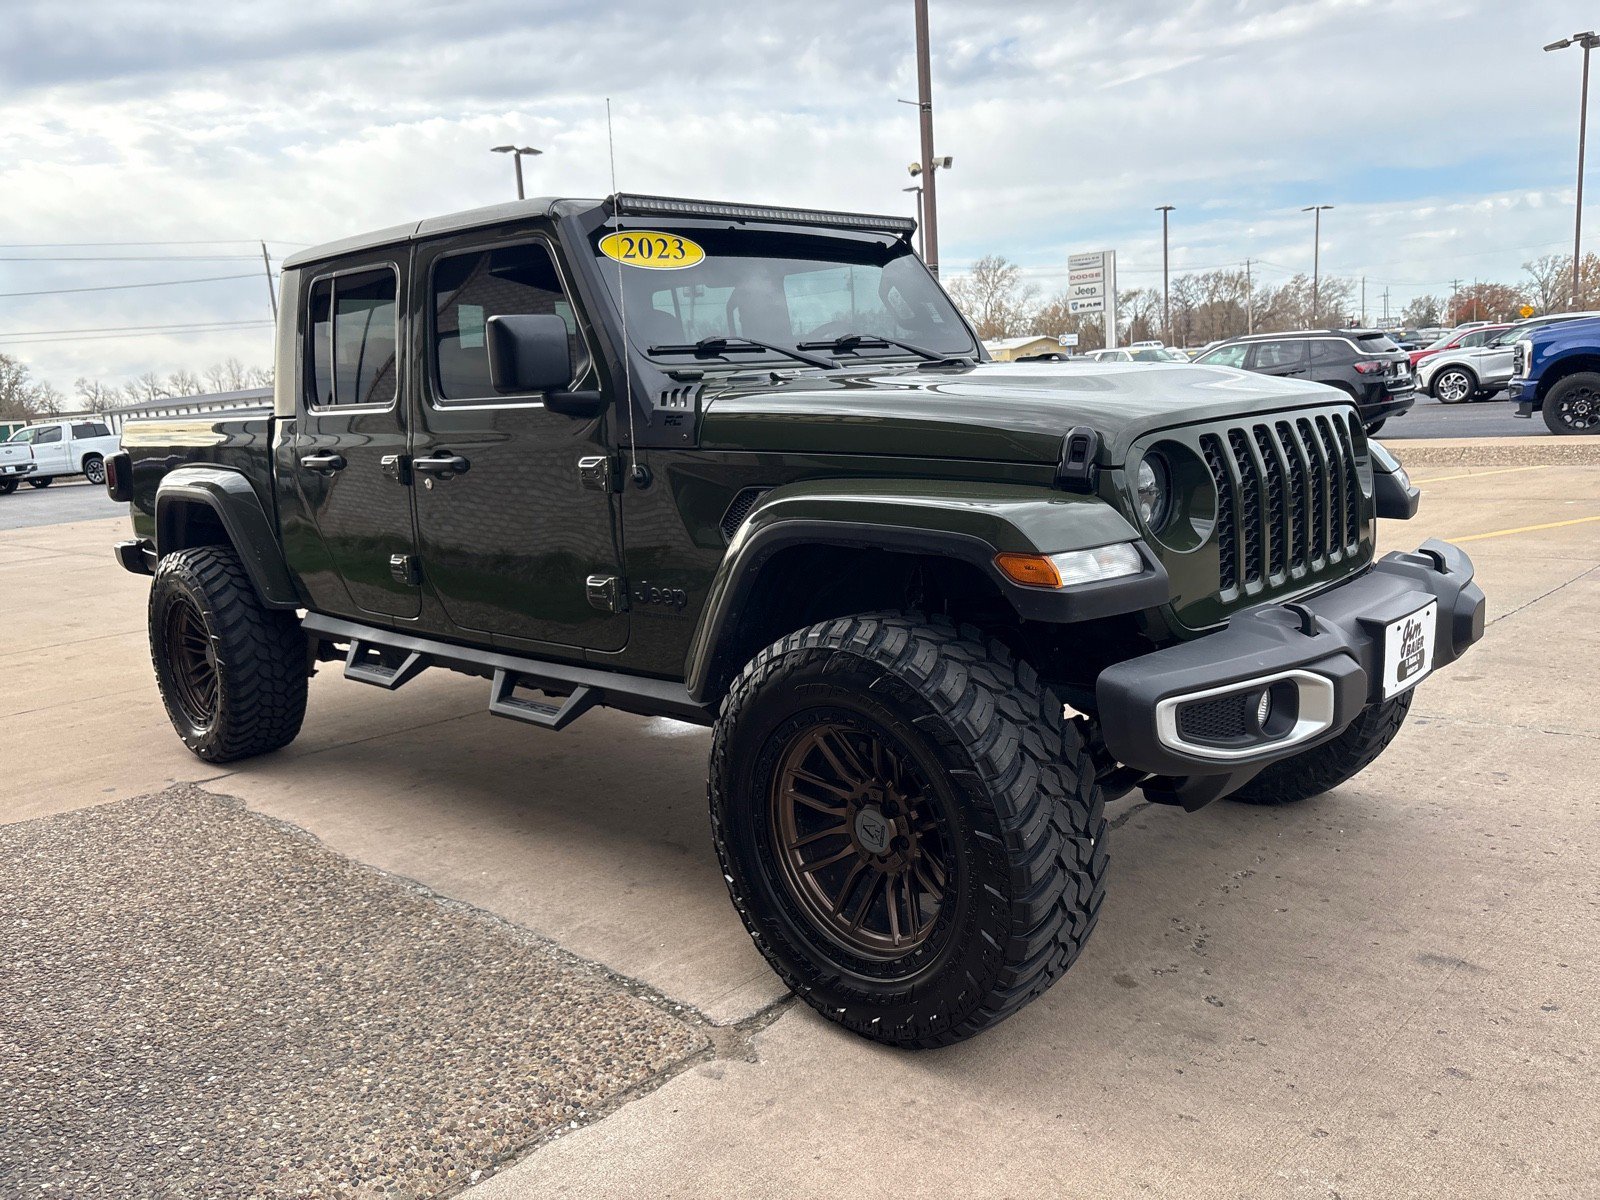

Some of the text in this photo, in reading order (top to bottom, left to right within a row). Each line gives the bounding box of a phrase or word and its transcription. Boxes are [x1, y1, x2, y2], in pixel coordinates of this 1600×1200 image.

[620, 237, 686, 259] 2023
[1070, 272, 1101, 280] DODGE
[1074, 286, 1096, 295] Jeep
[635, 580, 688, 612] Jeep
[1400, 619, 1422, 659] Jim
[1406, 635, 1424, 657] BAIER
